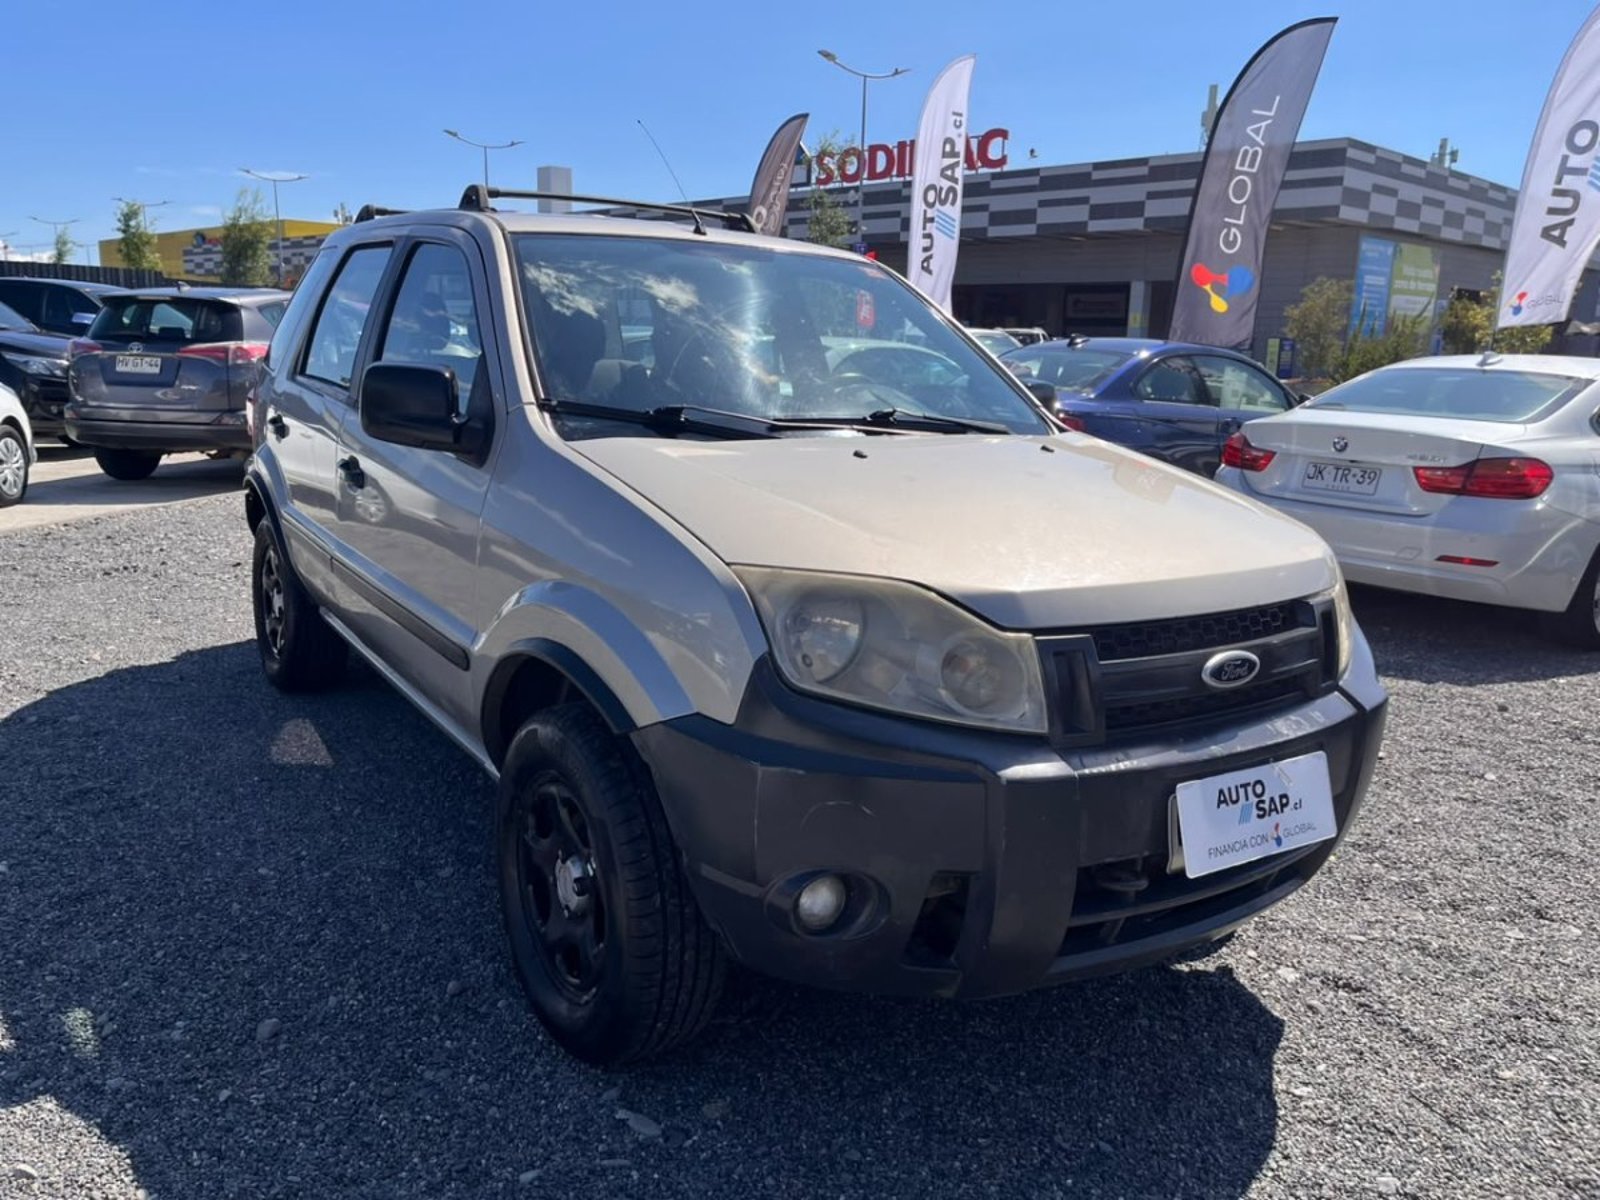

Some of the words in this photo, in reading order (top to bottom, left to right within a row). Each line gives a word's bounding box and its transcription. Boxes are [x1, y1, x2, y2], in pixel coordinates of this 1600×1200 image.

[816, 128, 1009, 186] SODIC
[1219, 94, 1280, 254] GLOBAL
[1540, 119, 1600, 249] AUTO
[921, 183, 939, 276] AUTO
[1221, 660, 1249, 681] Ford
[1216, 779, 1266, 809] AUTO
[1208, 838, 1249, 859] FINANCIA
[1249, 833, 1269, 848] CON
[1283, 822, 1317, 839] GLOBAL
